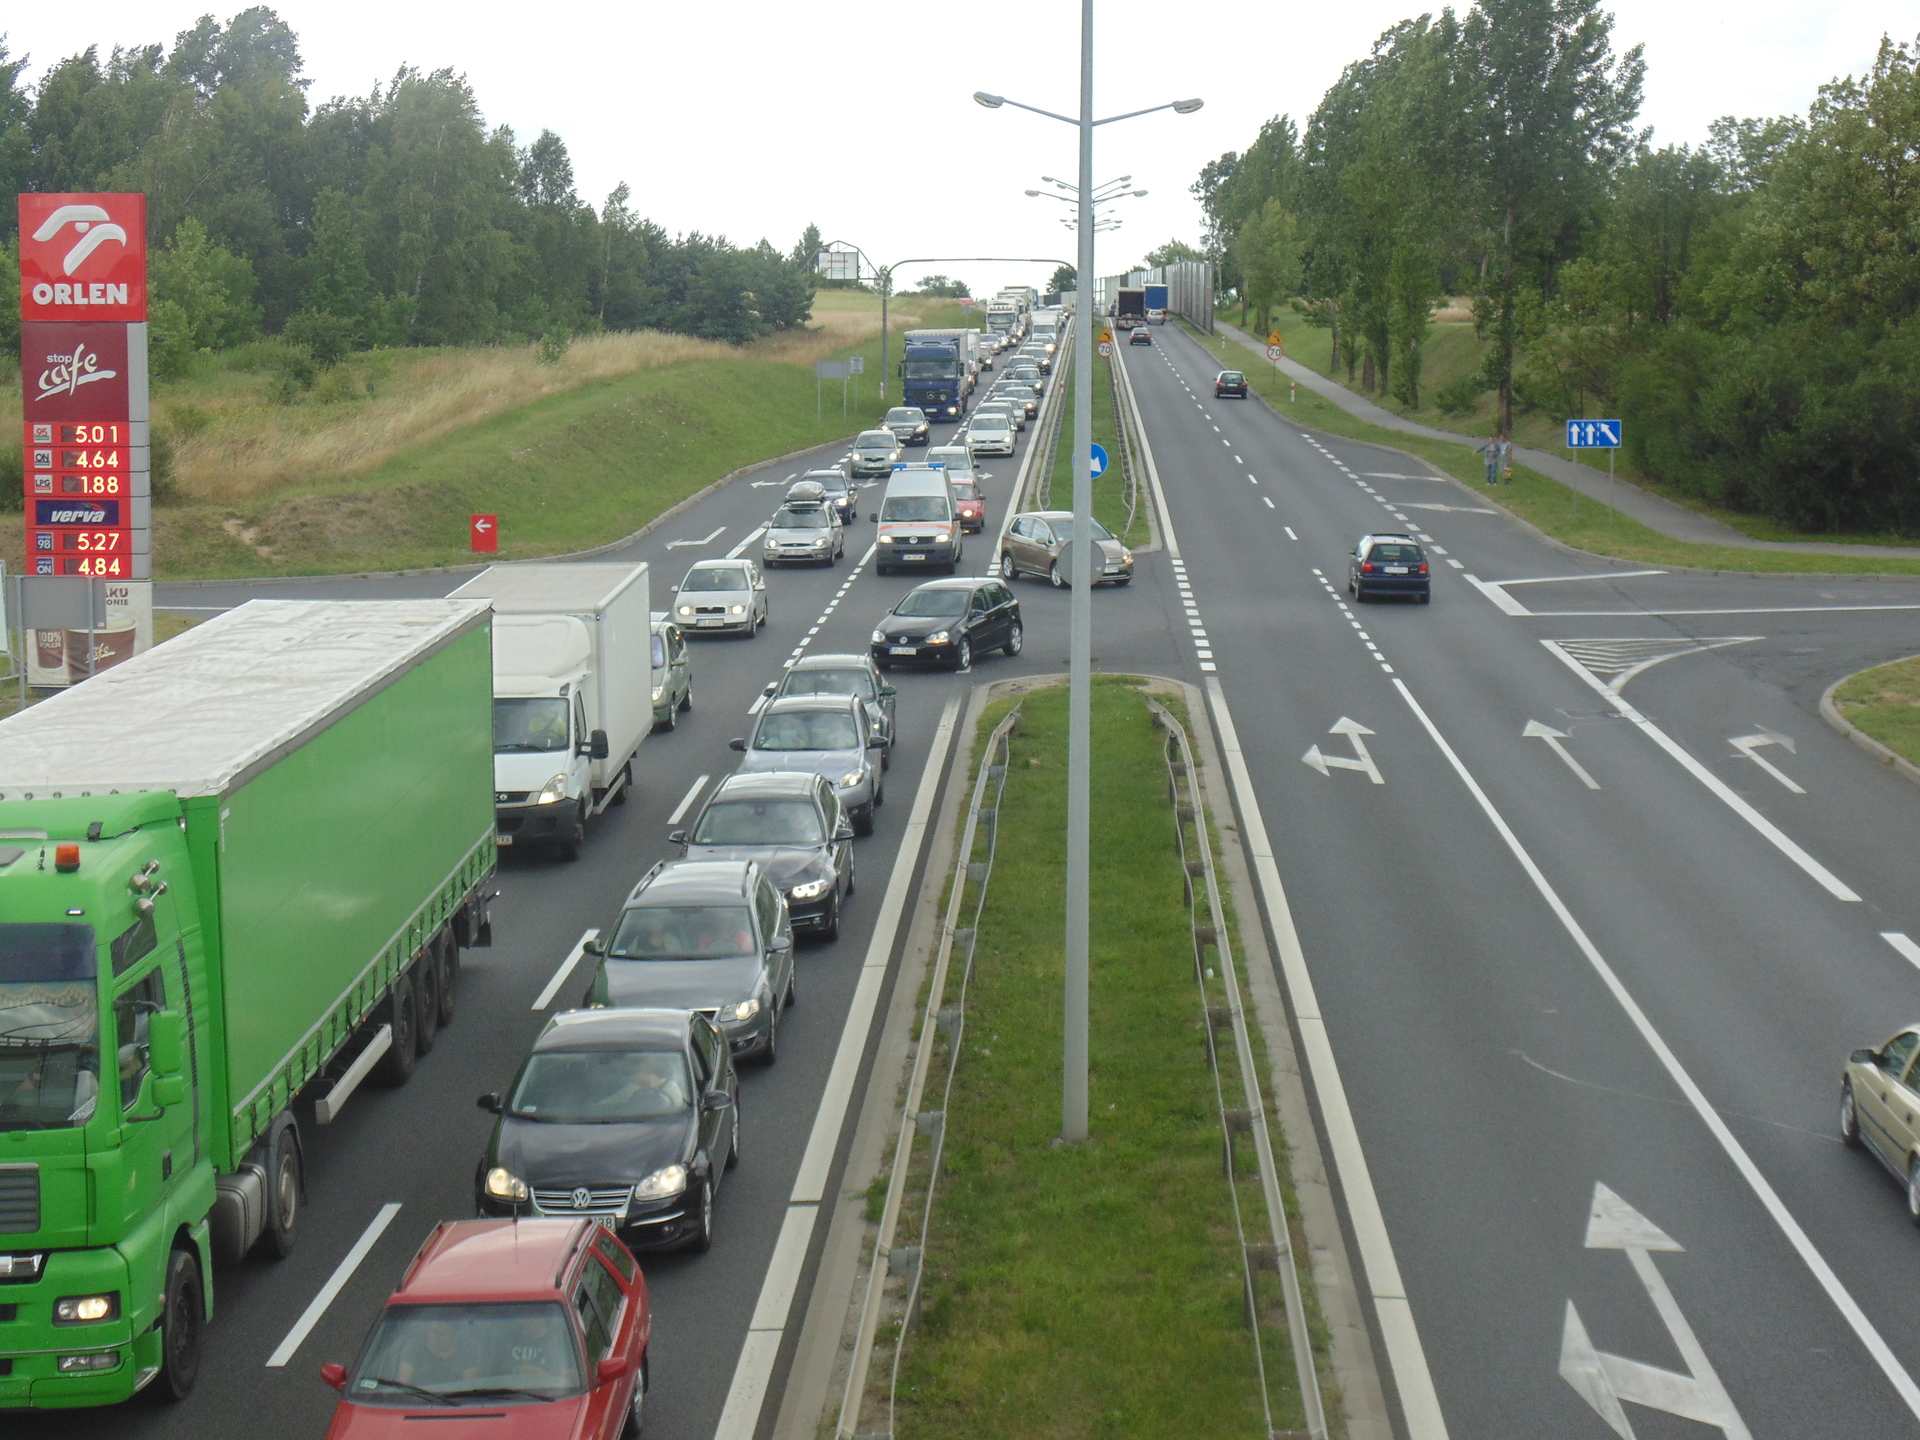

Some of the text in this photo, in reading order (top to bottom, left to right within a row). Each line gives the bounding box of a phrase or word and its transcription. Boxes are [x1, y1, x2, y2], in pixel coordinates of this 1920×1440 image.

[32, 282, 128, 305] ORLEN
[1100, 345, 1111, 354] 70
[1270, 348, 1281, 357] 70
[46, 353, 73, 365] stop
[36, 425, 118, 443] 95 5.01
[35, 451, 119, 468] ON 4.64
[35, 476, 119, 494] LPG 1.88
[51, 510, 106, 523] verva
[38, 533, 120, 551] 98 5.27
[37, 558, 121, 576] ON 4.84
[38, 631, 62, 643] 100%
